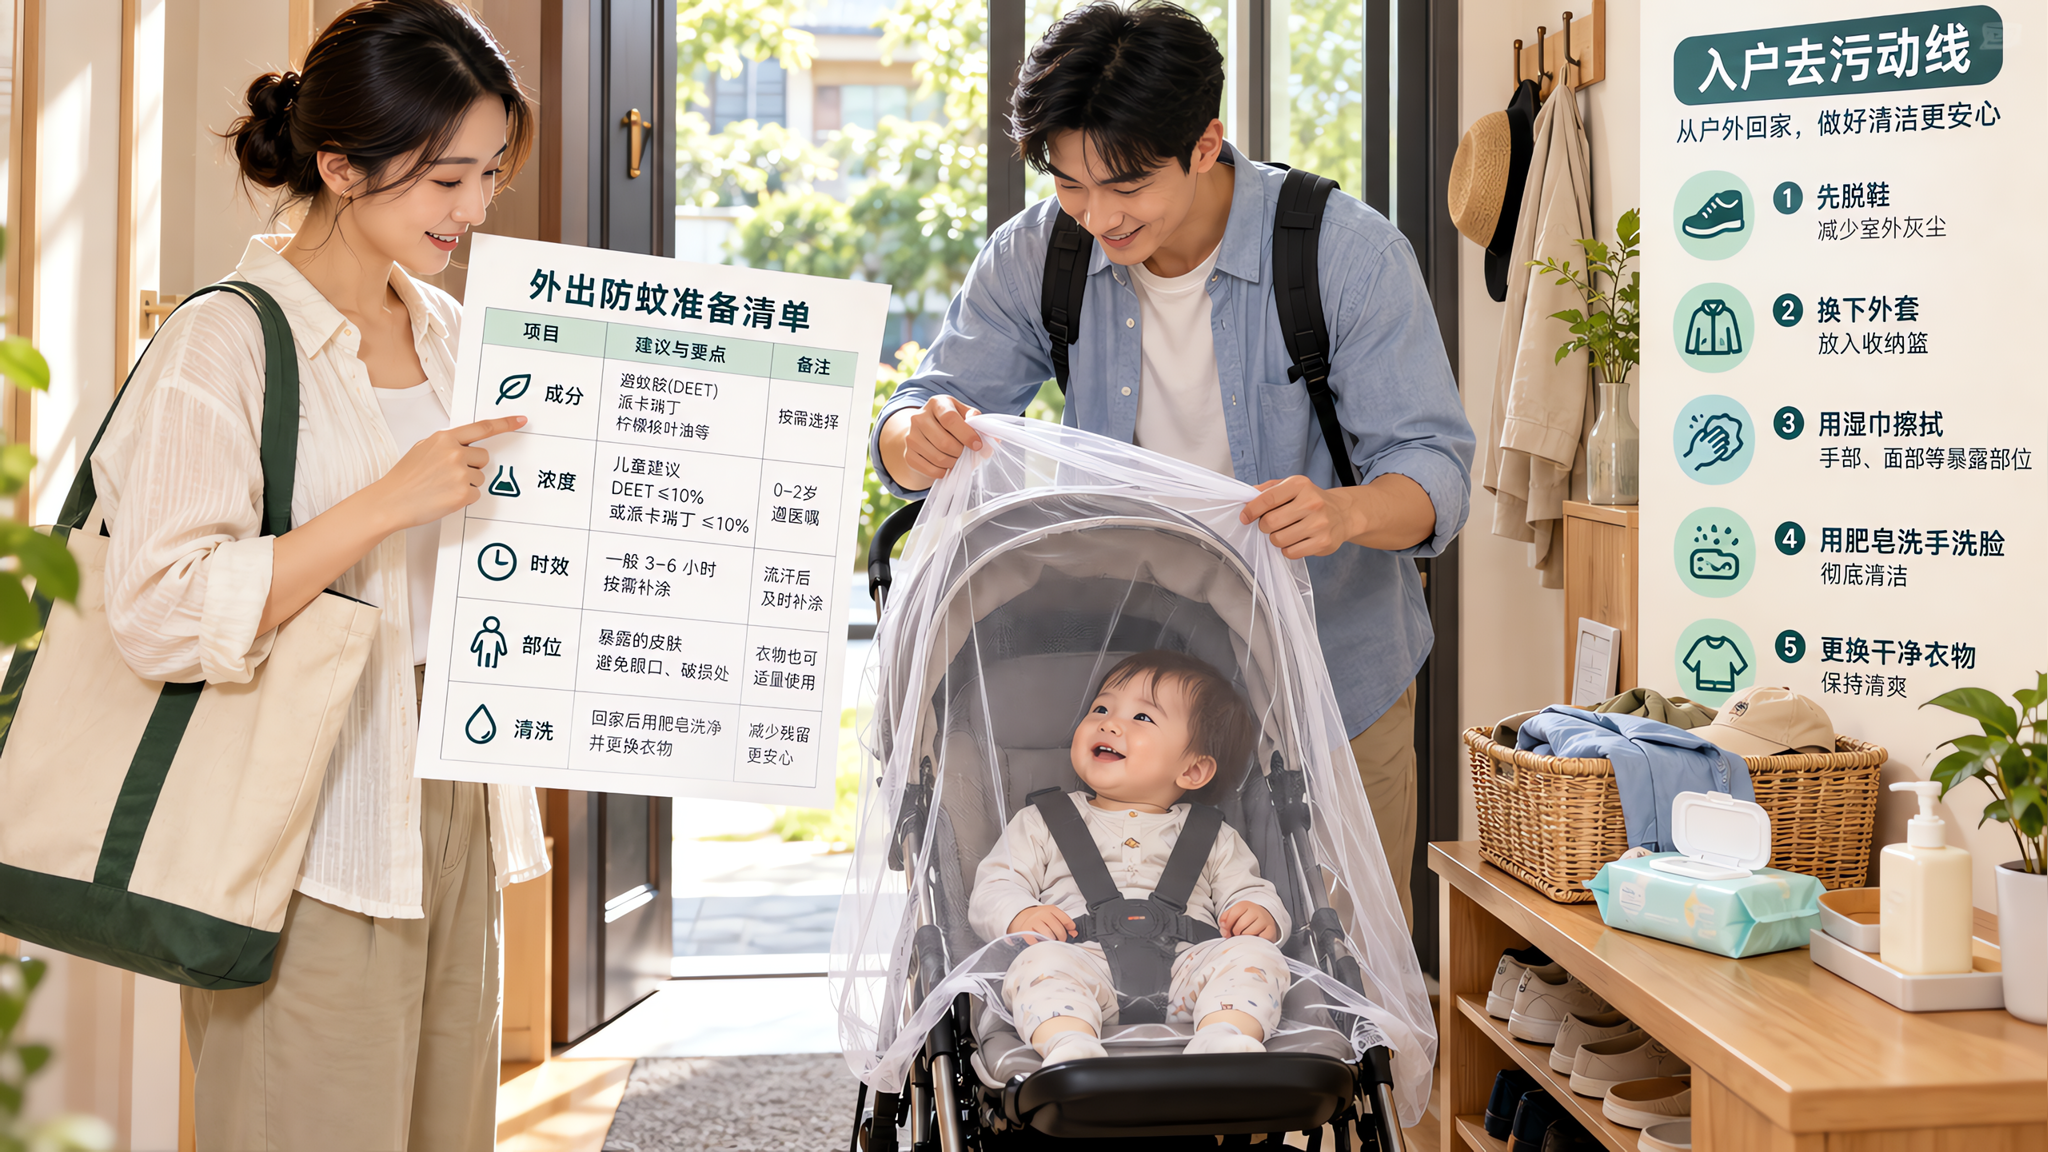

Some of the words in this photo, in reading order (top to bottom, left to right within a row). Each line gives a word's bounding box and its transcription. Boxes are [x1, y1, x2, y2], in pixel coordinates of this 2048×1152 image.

[1697, 22, 1971, 94] 入户去污动线
[1782, 187, 1791, 209] 1
[1816, 180, 1891, 211] 先脱鞋
[1817, 214, 1947, 242] 减少室外灰尘
[529, 267, 810, 334] 外出防蚊准备清单
[1781, 299, 1795, 321] 2
[1816, 294, 1920, 324] 换下外套
[522, 322, 559, 344] 项目
[1818, 331, 1929, 356] 放入收纳篮
[634, 336, 727, 364] 建议与要点
[796, 355, 831, 376] 备注
[544, 383, 585, 406] 成分
[778, 408, 839, 431] 按需选择
[1782, 412, 1795, 434] 3
[1818, 410, 1944, 438] 用湿巾擦拭
[537, 469, 577, 493] 浓度
[611, 480, 655, 499] DEET
[608, 503, 697, 528] 或派卡瑞丁
[1782, 528, 1798, 549] 4
[1819, 526, 2006, 557] 用肥皂洗手洗脸
[530, 554, 570, 577] 时效
[605, 552, 640, 570] 一般
[682, 558, 717, 579] 小时
[763, 565, 811, 587] 流汗后
[1820, 561, 1908, 588] 彻底清洁
[760, 590, 824, 612] 及时补涂
[522, 634, 563, 658] 部位
[755, 644, 818, 667] 衣物也可
[1784, 636, 1797, 657] 5
[1820, 636, 1976, 670] 更换干净衣物
[1820, 670, 1908, 699] 保持清爽
[513, 718, 554, 742] 清洗
[591, 709, 722, 737] 回家后用肥皂洗净
[748, 722, 811, 744] 减少残留
[746, 746, 794, 766] 更安心
